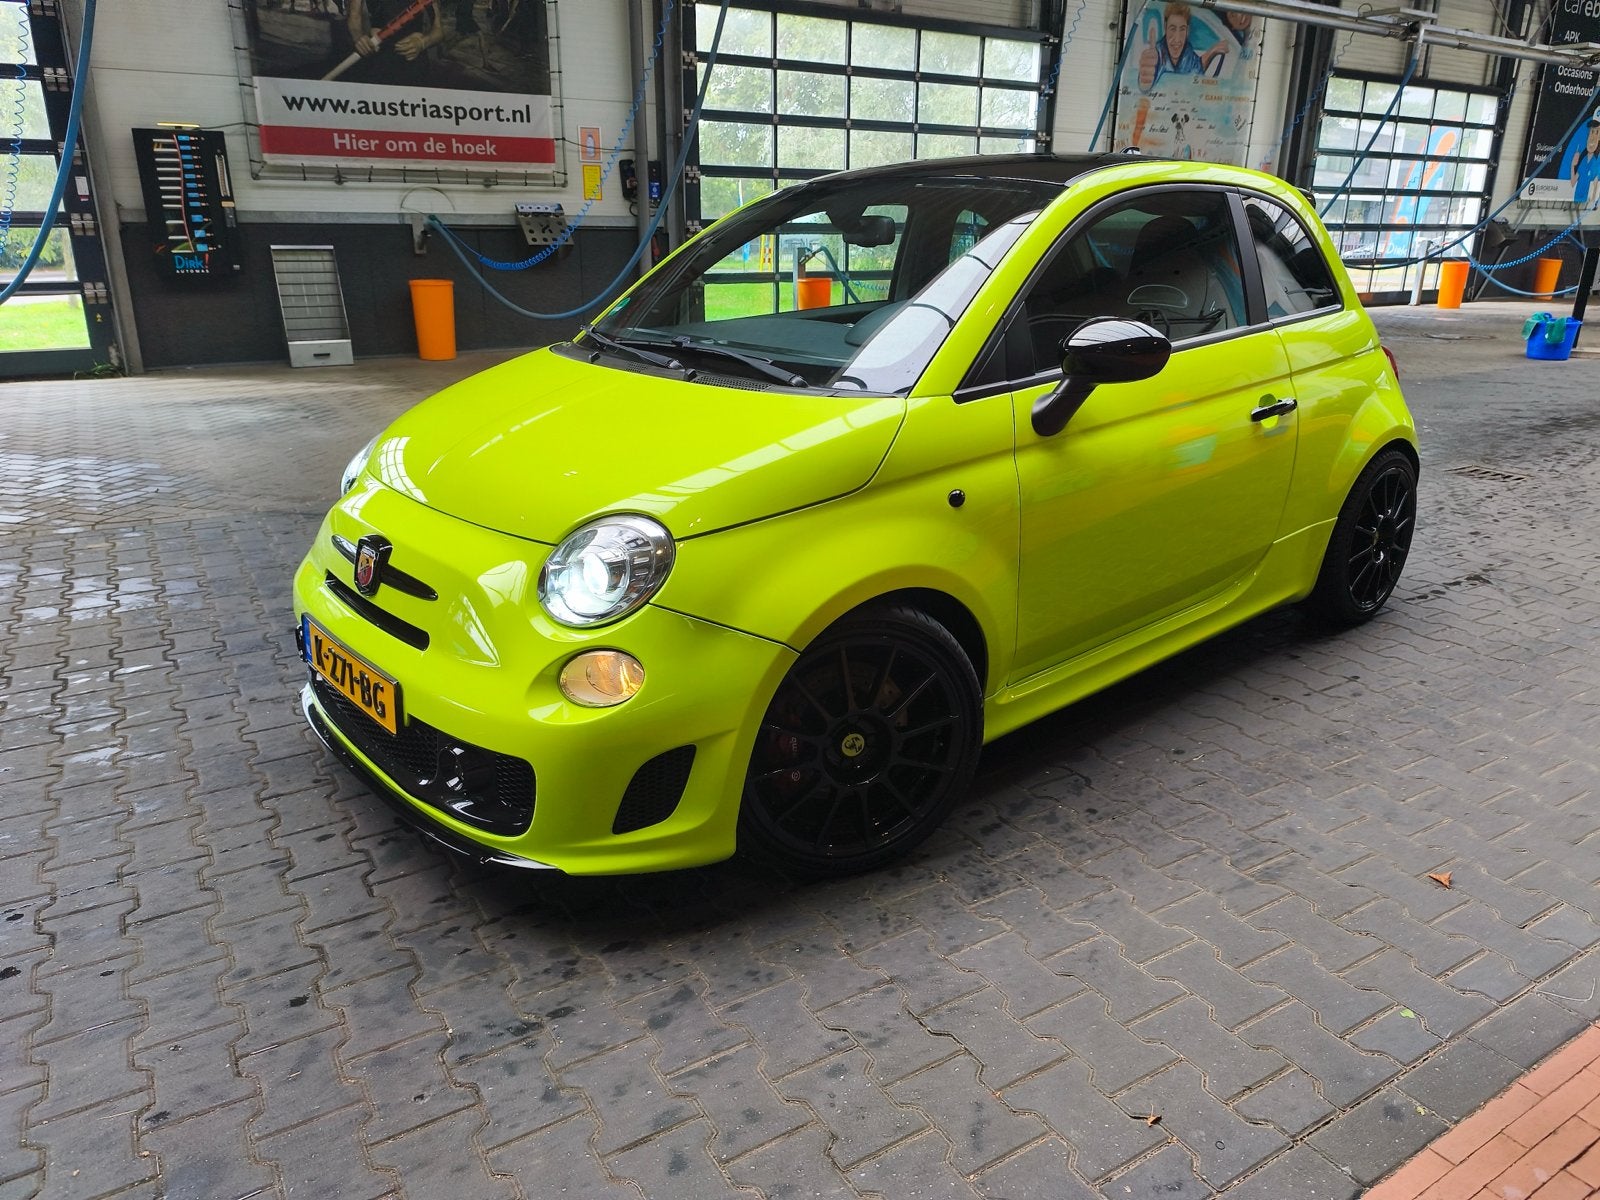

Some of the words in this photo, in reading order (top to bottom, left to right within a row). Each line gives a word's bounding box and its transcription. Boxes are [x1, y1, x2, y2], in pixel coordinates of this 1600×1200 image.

[1563, 30, 1581, 43] APK
[1557, 65, 1593, 80] Occasions
[1554, 81, 1594, 97] Onderhoud
[281, 94, 532, 126] www.austriasport.nl
[333, 132, 378, 152] Hier
[385, 139, 417, 153] om
[423, 136, 446, 154] de
[451, 138, 497, 156] hoek
[313, 634, 387, 719] K-271-BG
